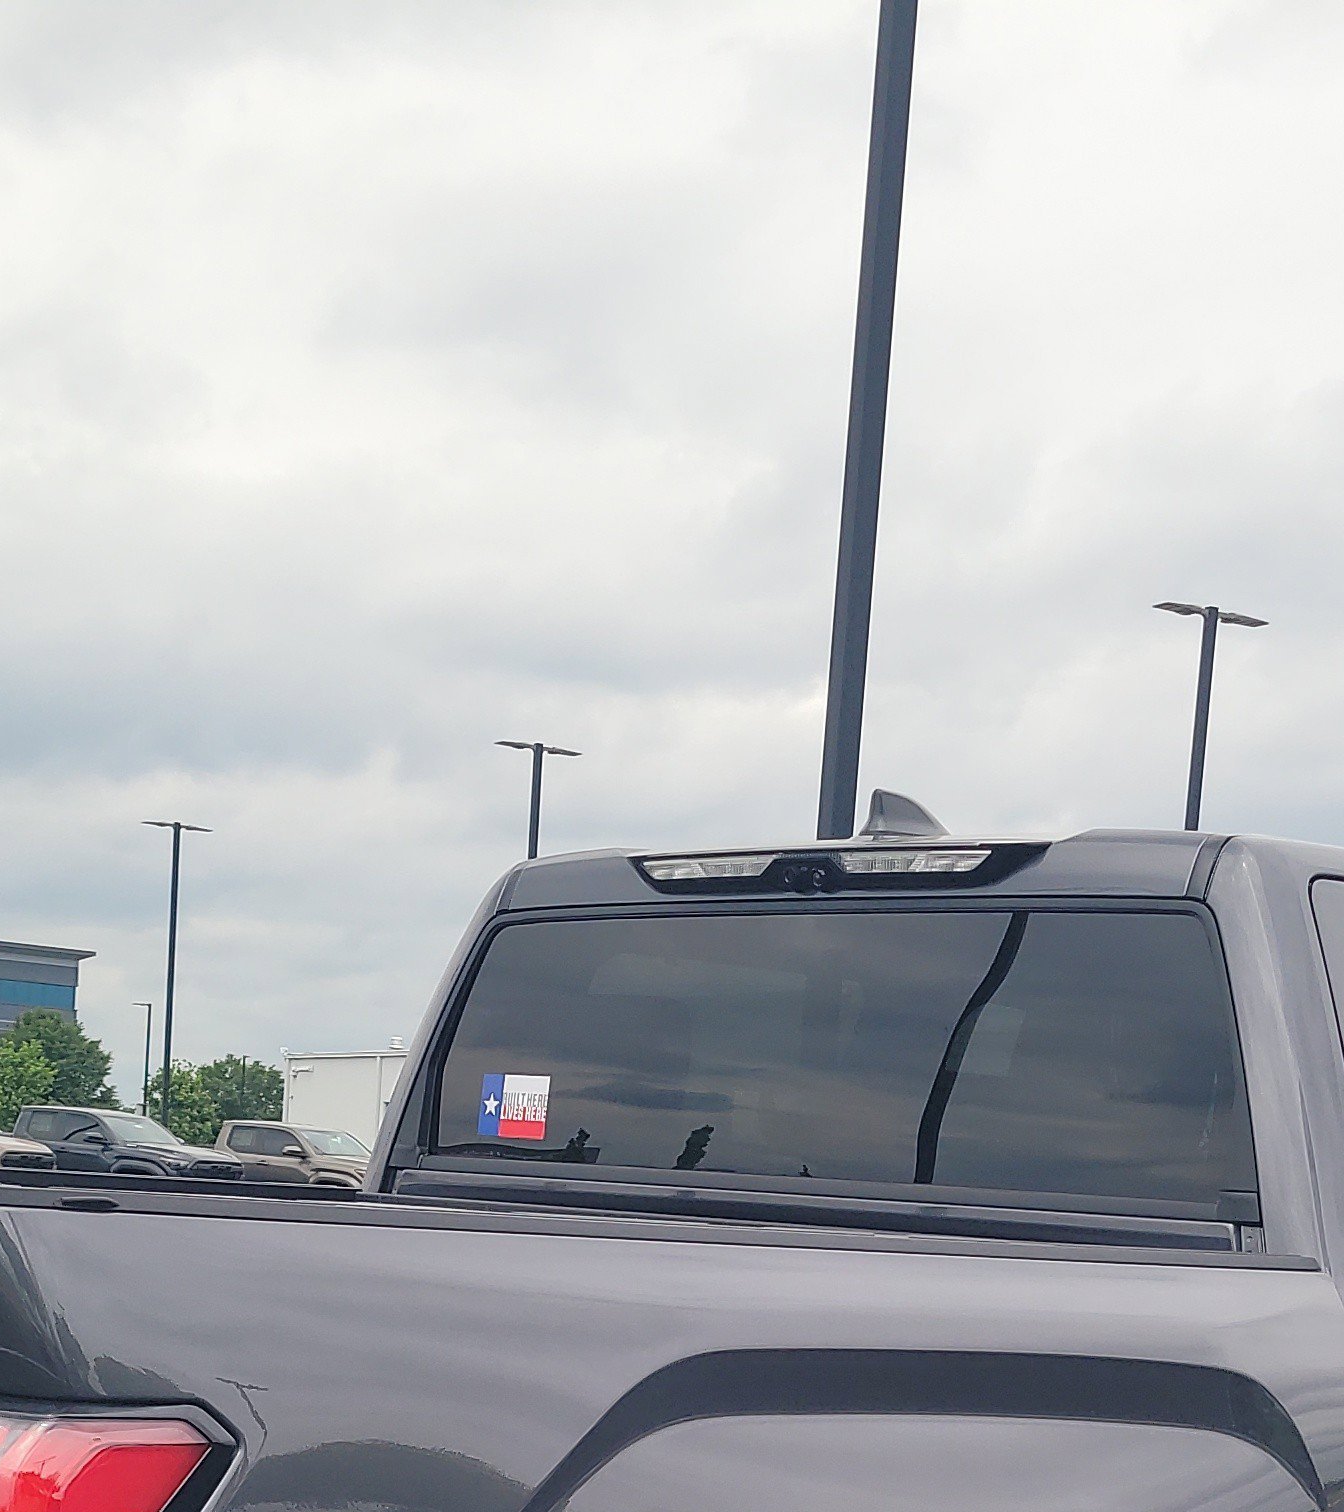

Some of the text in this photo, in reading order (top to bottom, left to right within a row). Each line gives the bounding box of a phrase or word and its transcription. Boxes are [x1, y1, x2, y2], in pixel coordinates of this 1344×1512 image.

[503, 1092, 548, 1108] BUILT HERE
[501, 1106, 547, 1121] LIVES HERE
